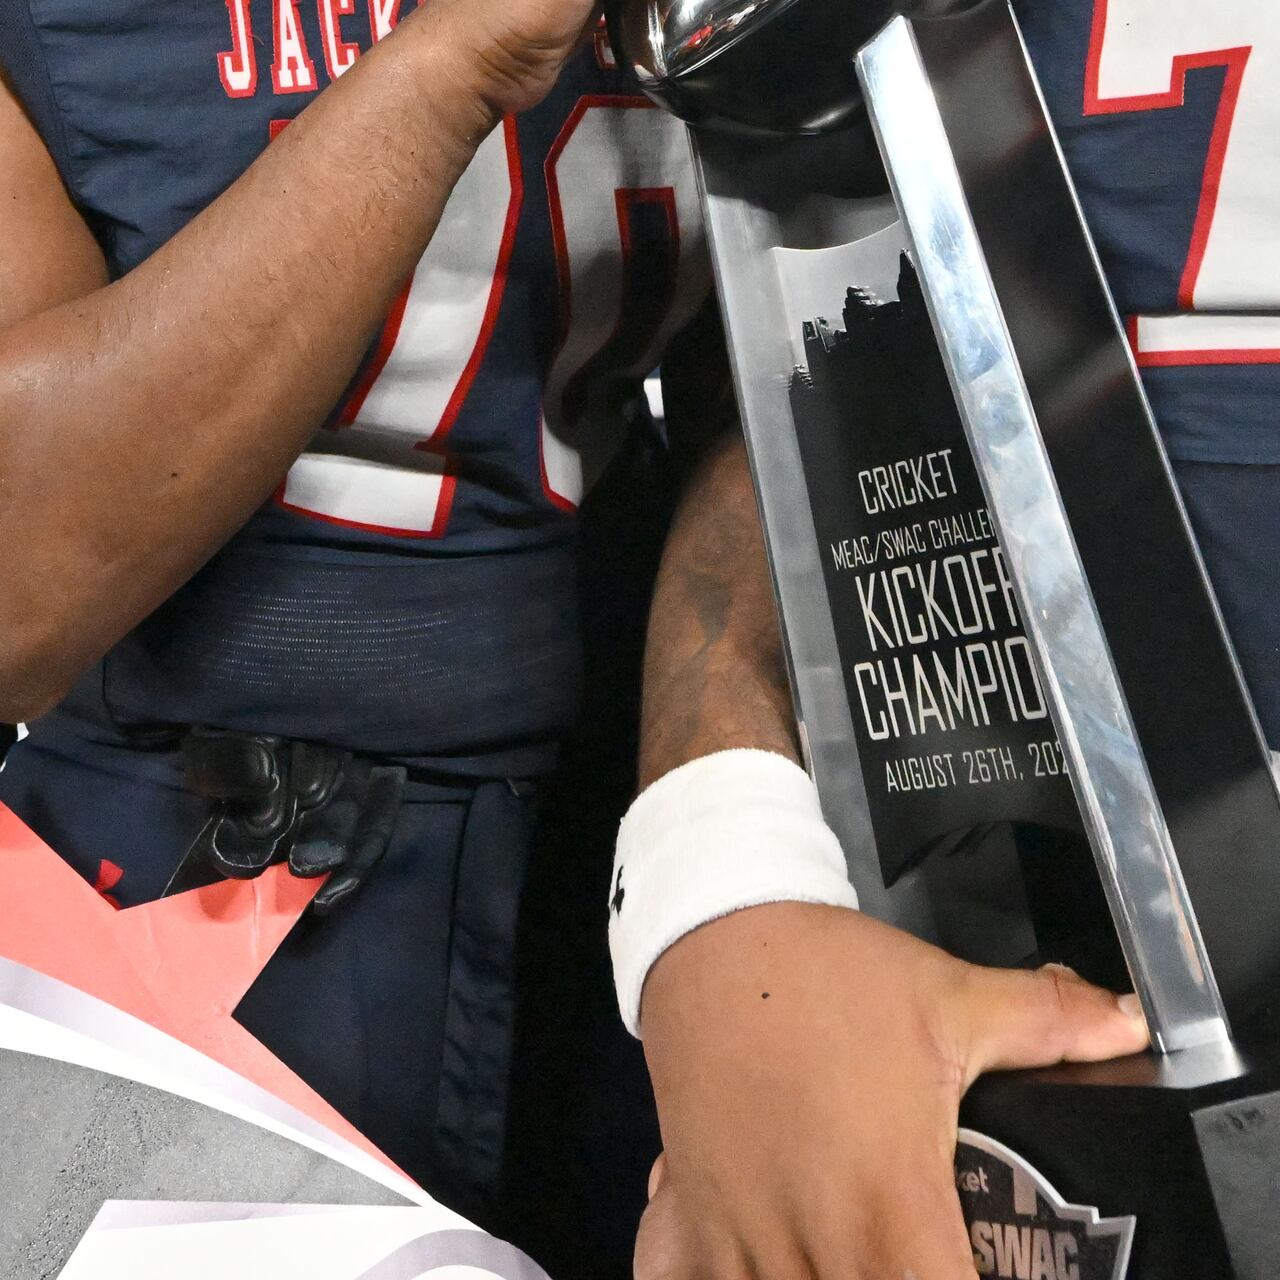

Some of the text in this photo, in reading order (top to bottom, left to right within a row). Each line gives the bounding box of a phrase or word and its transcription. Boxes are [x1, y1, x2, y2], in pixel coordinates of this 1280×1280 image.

[857, 448, 958, 515] CRICKET
[830, 523, 927, 571] MEAC/SWAC
[885, 753, 957, 793] AUGUST
[962, 745, 1024, 785] 26TH,
[972, 1220, 1080, 1280] SWAC
